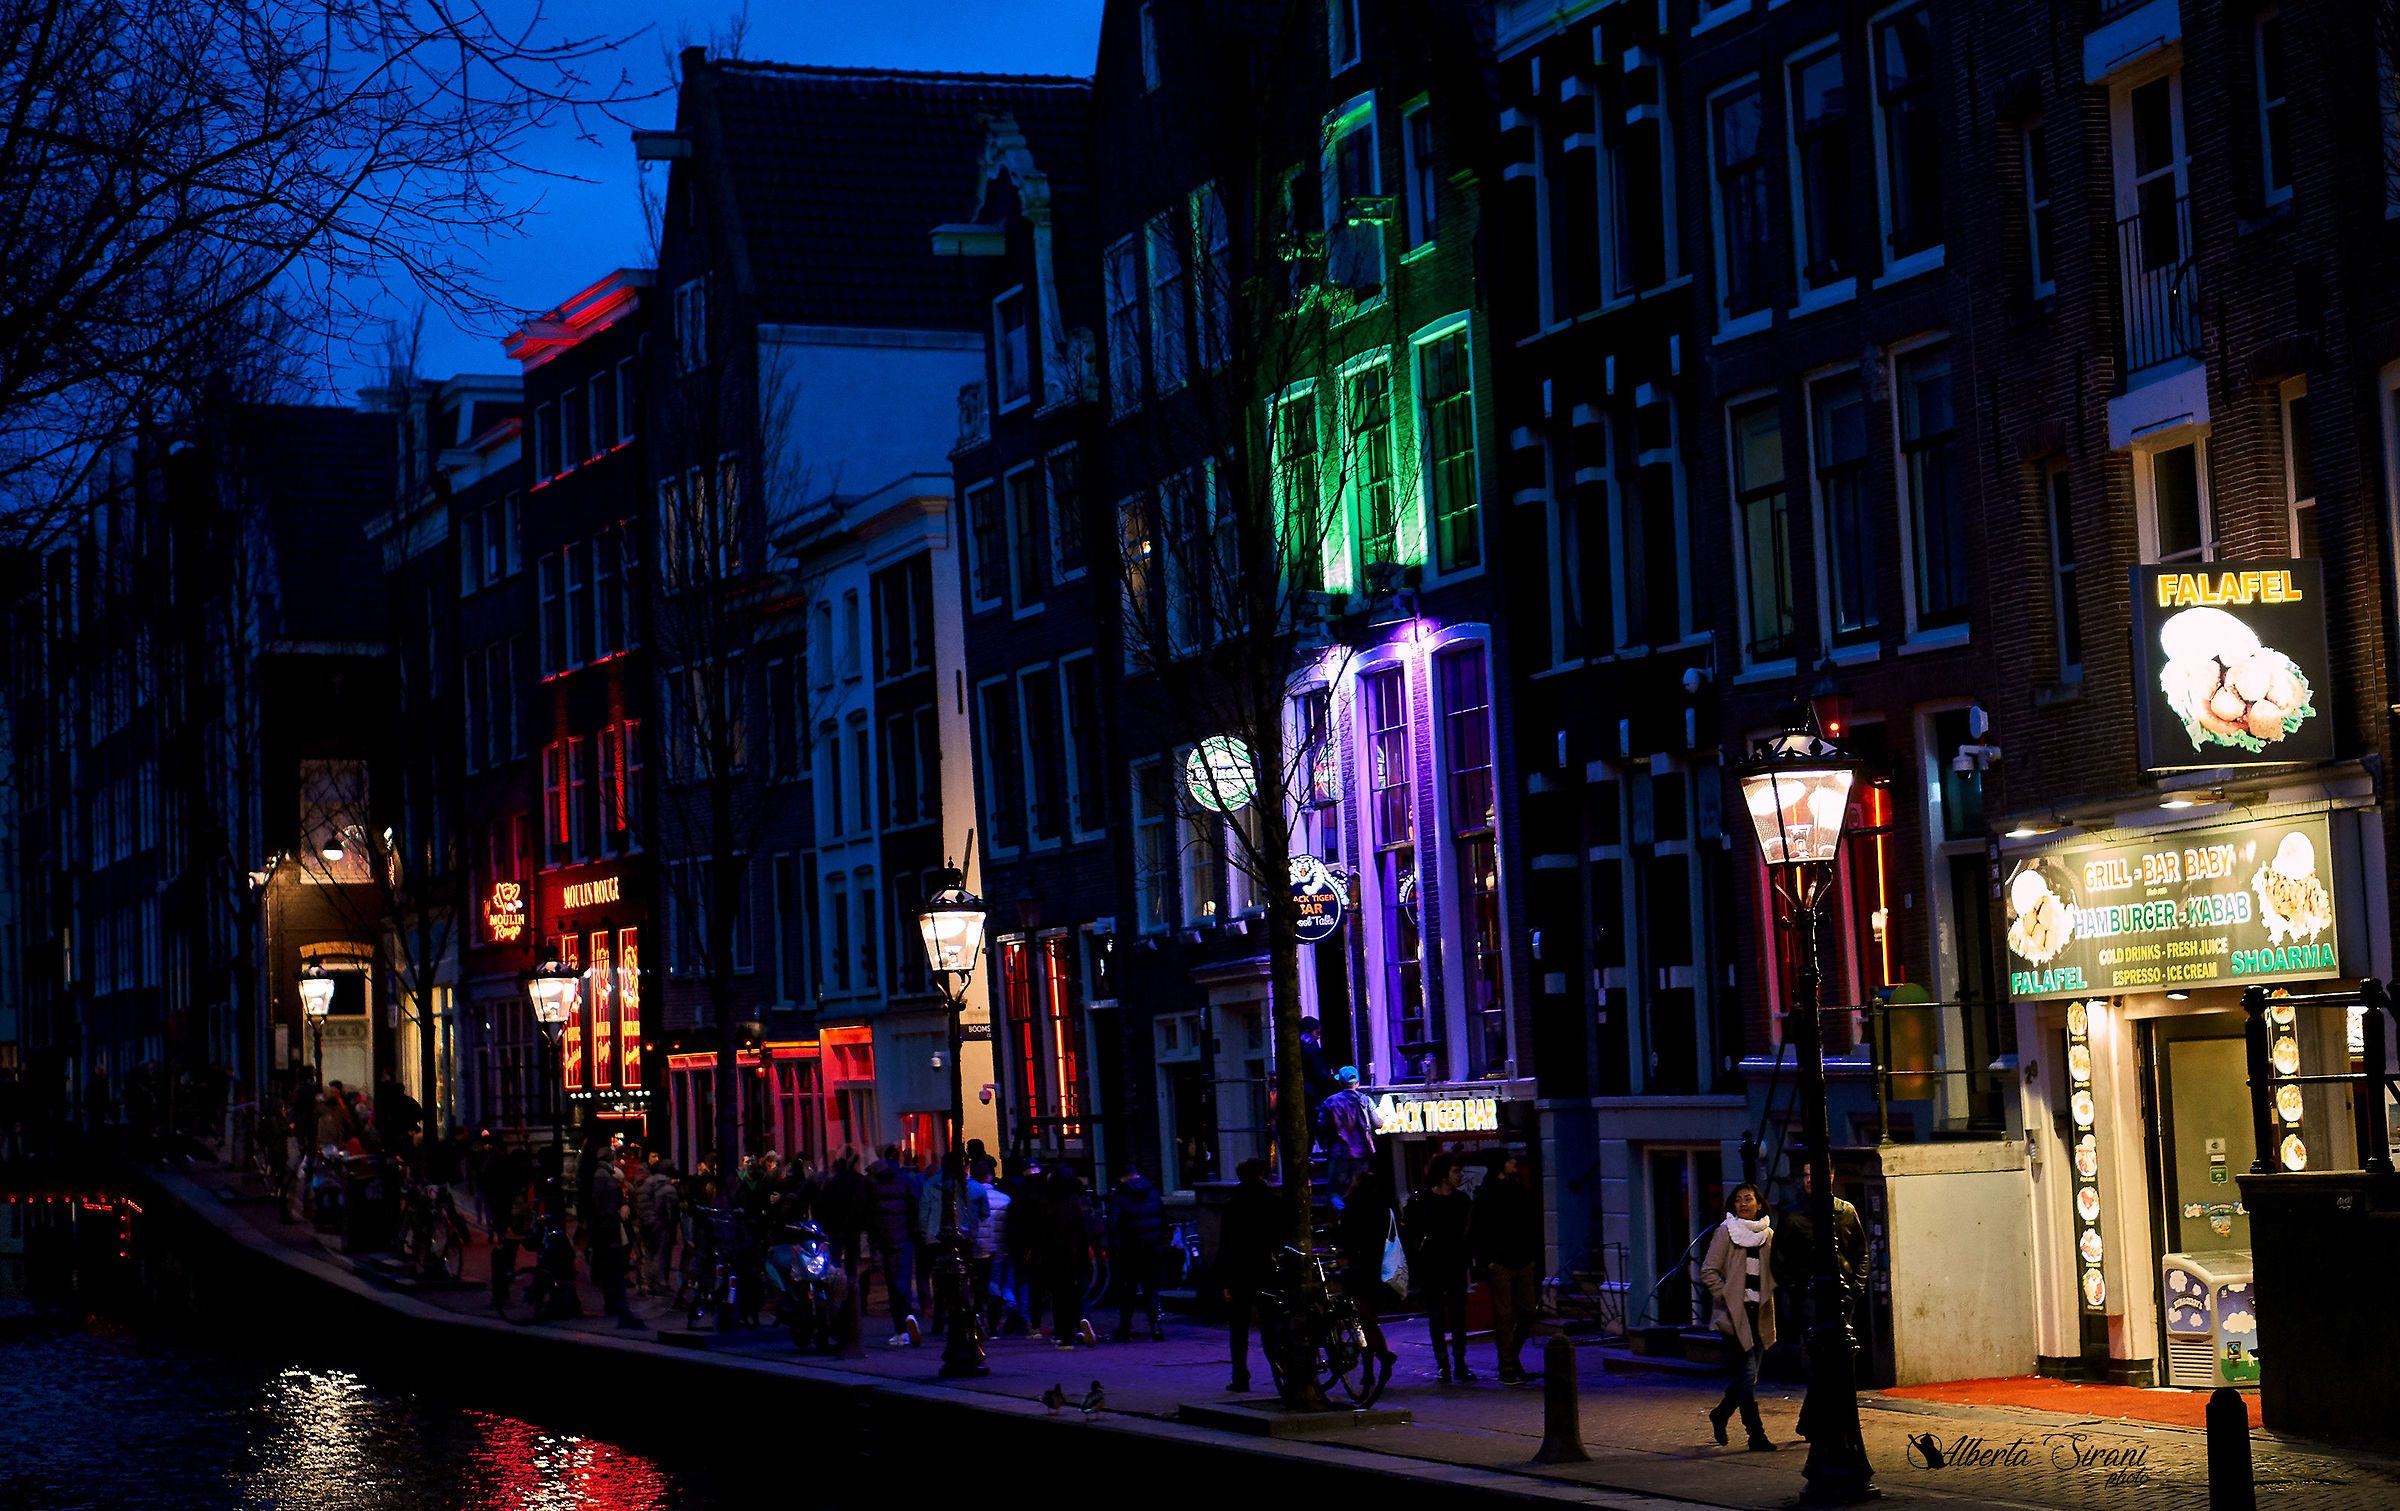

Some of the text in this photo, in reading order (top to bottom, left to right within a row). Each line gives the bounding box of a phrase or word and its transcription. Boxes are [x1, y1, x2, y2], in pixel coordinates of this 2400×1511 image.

[2157, 570, 2303, 607] FALAFEL
[2083, 859, 2132, 892] GRILL
[2142, 852, 2181, 885] BAR
[2184, 844, 2234, 881] BABY
[563, 876, 620, 909] MOULIN ROUGE
[1312, 894, 1335, 902] TIGER
[489, 914, 525, 926] MOULIN
[2074, 900, 2178, 940] HAMBURGER
[2187, 892, 2251, 928] KABAB
[494, 924, 521, 941] Rouge
[2099, 947, 2124, 965] COLD
[2125, 944, 2160, 962] DRINKS
[2167, 940, 2198, 959] FRESH
[2199, 937, 2228, 955] JUICE
[2231, 943, 2336, 974] SHOARMA
[2011, 967, 2088, 995] FALAFEL
[2112, 966, 2160, 986] ESPRESSO
[2167, 964, 2183, 981] ICE
[2184, 962, 2217, 980] CREAM
[1376, 1099, 1498, 1134] ACK TIGER BAR
